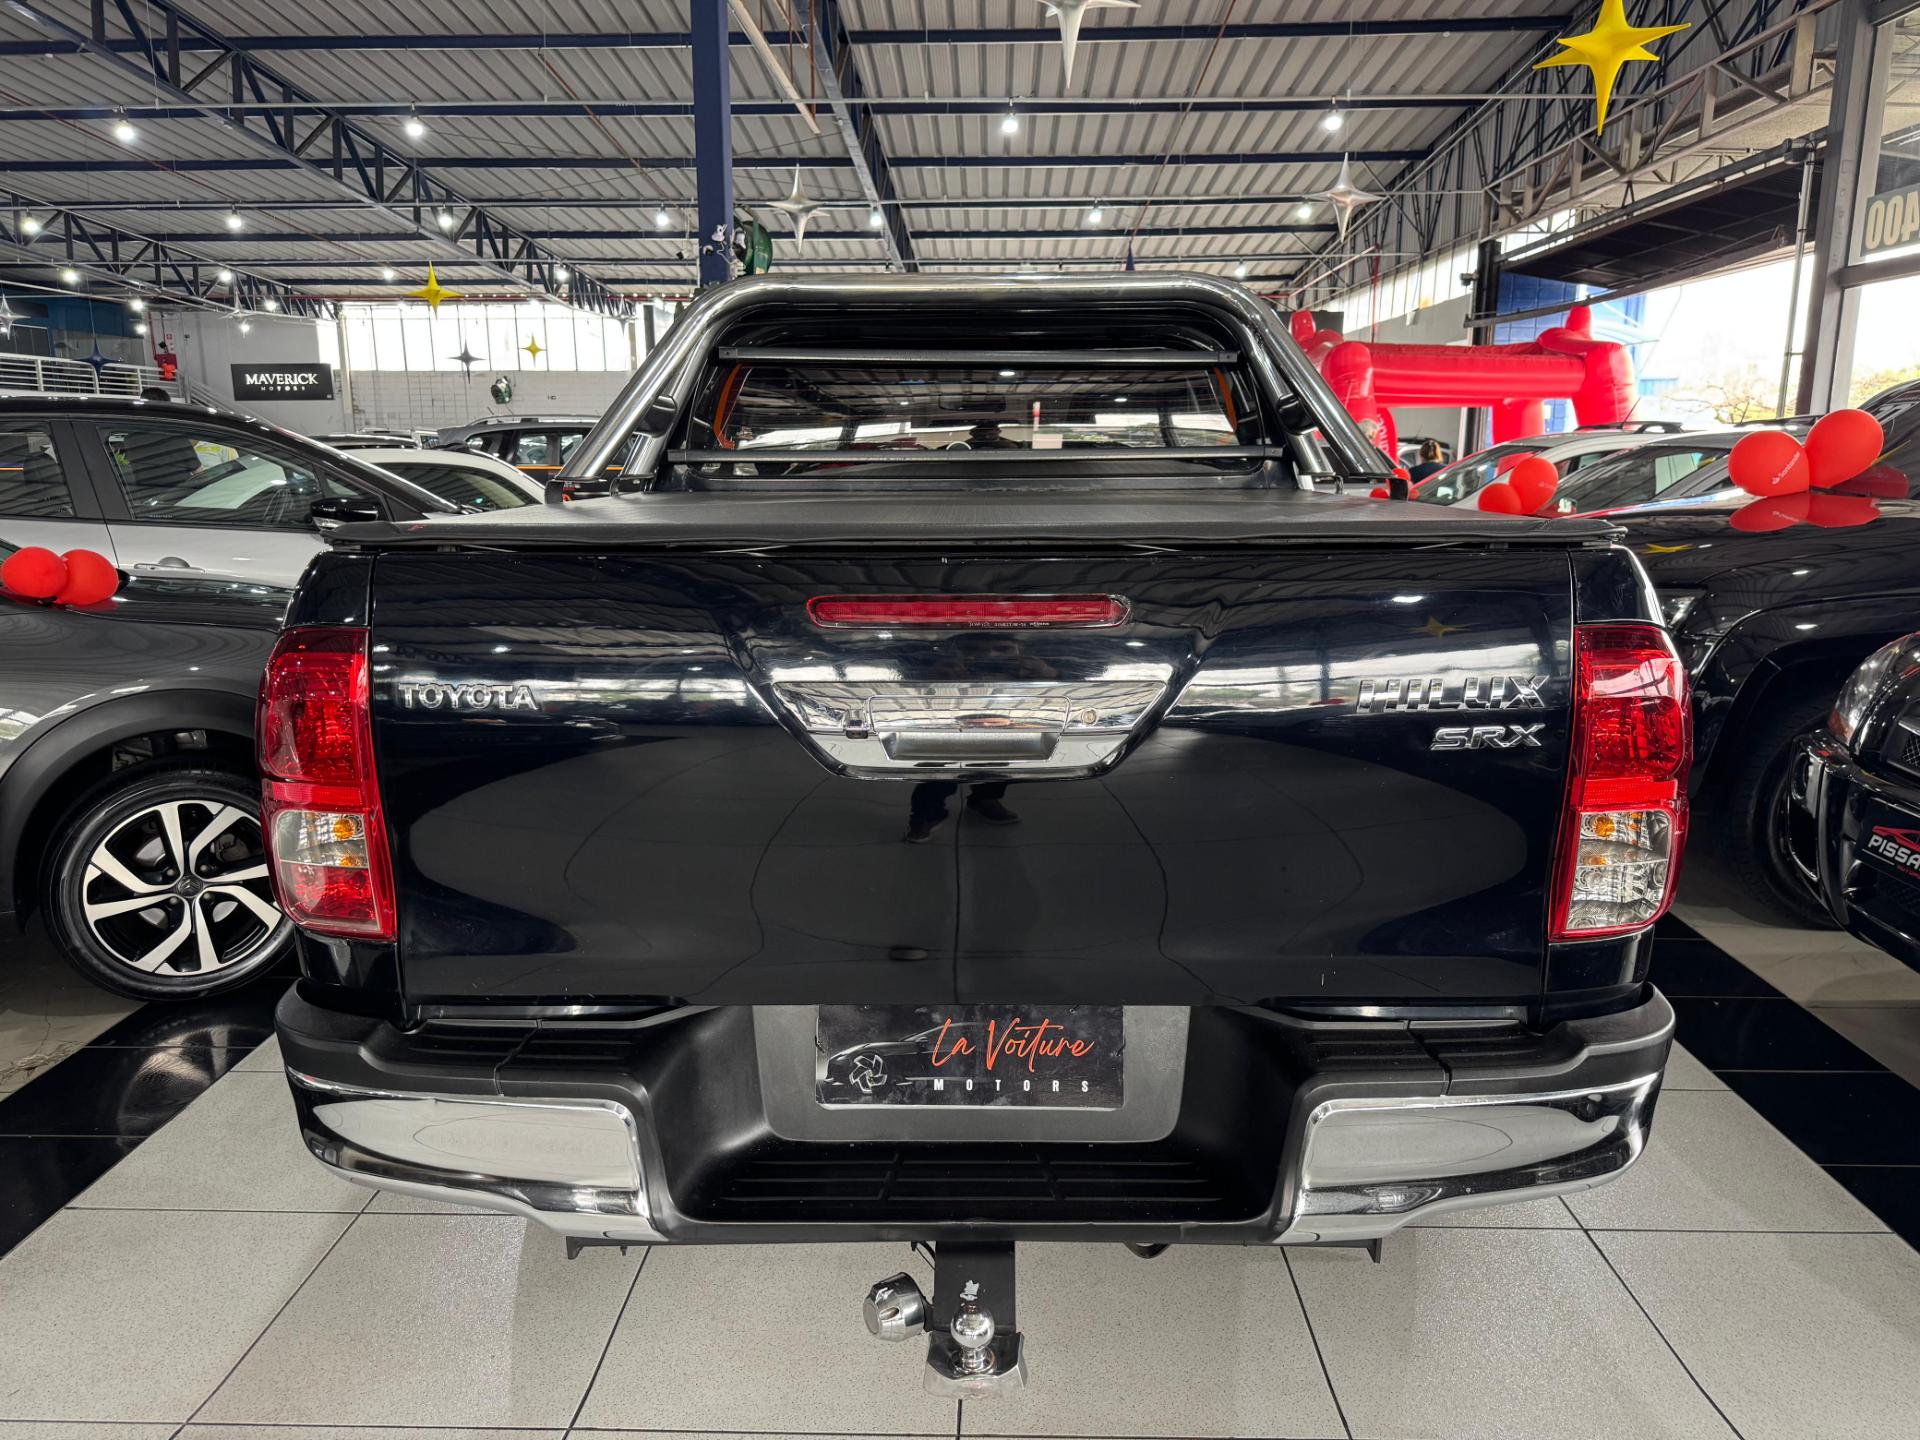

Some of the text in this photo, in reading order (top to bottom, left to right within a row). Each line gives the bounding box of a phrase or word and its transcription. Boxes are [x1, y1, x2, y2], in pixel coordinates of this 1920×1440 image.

[244, 373, 319, 385] MAVERICK
[398, 683, 538, 711] TOYOTA
[1356, 675, 1550, 713] HILUX
[1430, 723, 1546, 751] SRX
[1867, 834, 1920, 871] PISSA
[931, 1016, 1095, 1073] La Voiture
[933, 1078, 1089, 1093] MOTORS
